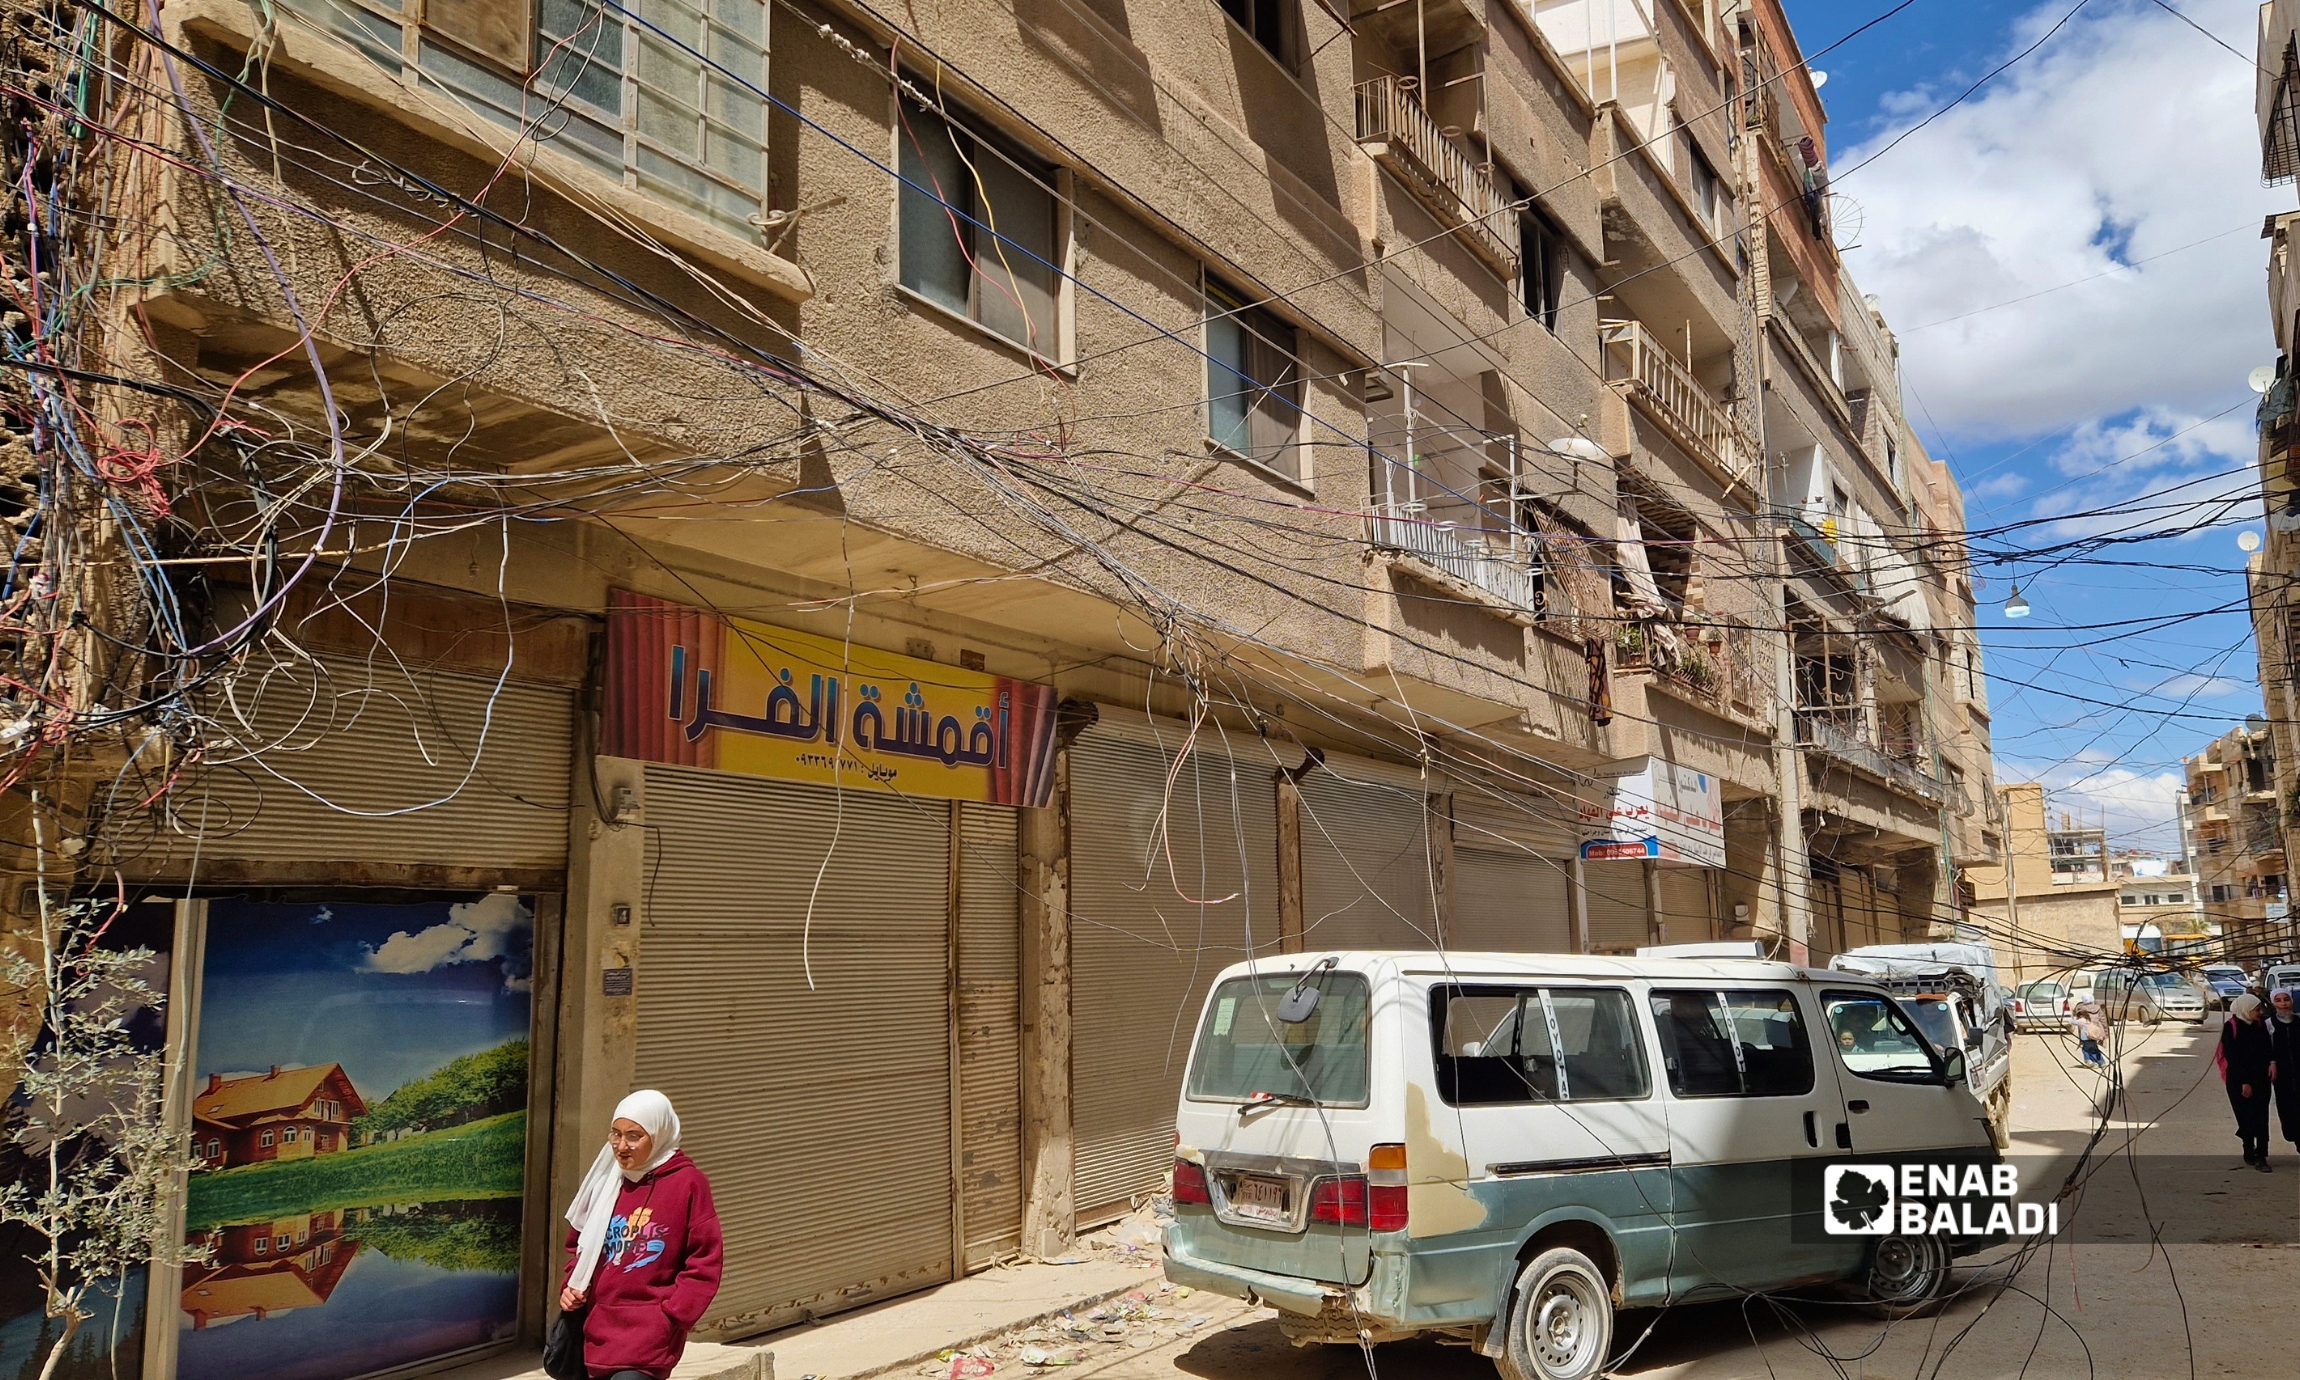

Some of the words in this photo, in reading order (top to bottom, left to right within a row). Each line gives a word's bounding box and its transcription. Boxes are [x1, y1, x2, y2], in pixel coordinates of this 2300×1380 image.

[668, 644, 838, 743] الفرا
[853, 682, 1009, 769] أقمشة
[796, 753, 857, 772] ٠٩٣٣٦٩٧٧١
[868, 763, 897, 782] موبايل
[1589, 849, 1605, 857] Mob:
[1546, 1005, 1568, 1093] TOYOTA
